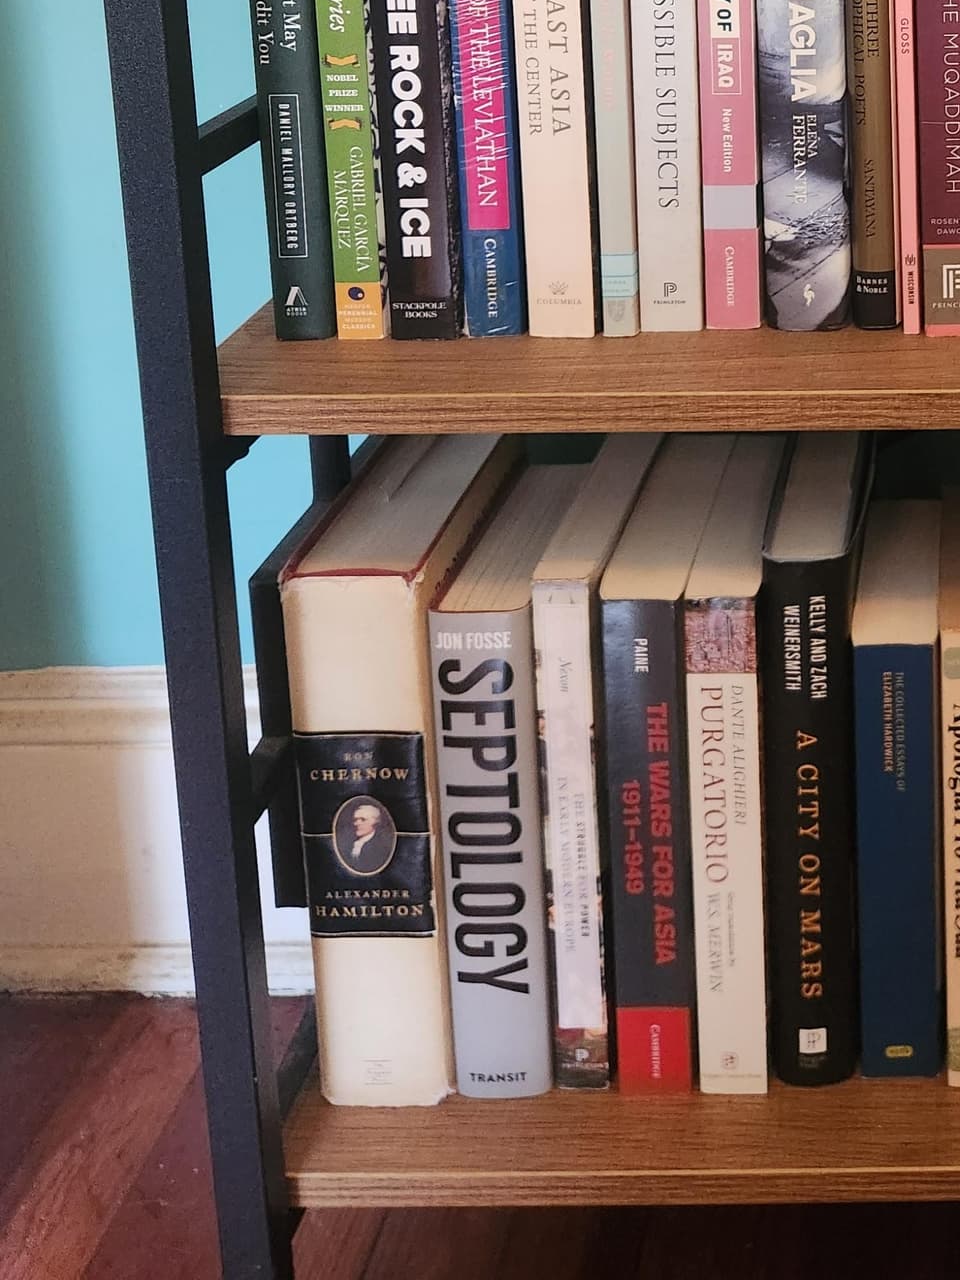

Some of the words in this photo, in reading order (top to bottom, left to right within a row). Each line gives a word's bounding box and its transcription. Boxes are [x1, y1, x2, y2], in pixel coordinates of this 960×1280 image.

[281, 13, 301, 52] May
[716, 8, 732, 32] OF
[900, 18, 909, 54] GLOSS
[389, 45, 426, 155] ROCK
[550, 68, 571, 136] ASIA
[651, 88, 679, 209] SUBJECTS
[396, 162, 428, 188] &
[399, 198, 432, 258] ICE
[484, 238, 498, 318] CAMBRIDGE
[809, 596, 826, 633] KELLY
[435, 633, 462, 649] JON
[467, 632, 512, 649] FOSSE
[633, 638, 649, 673] PAINE
[784, 605, 802, 690] WEINERSMITH
[809, 639, 826, 662] AND
[810, 667, 827, 699] ZACH
[646, 702, 669, 753] THE
[731, 685, 745, 736] DANTE
[797, 730, 818, 750] A
[310, 768, 409, 781] CHERNOW
[649, 760, 672, 837] WARS
[700, 687, 729, 884] PURGATORIO
[732, 745, 746, 825] ALIGHIERI
[438, 658, 530, 994] SEPTOLOGY
[797, 764, 820, 840] CITY
[326, 890, 410, 899] ALEXANDER
[651, 846, 674, 897] FOR
[800, 856, 820, 896] ON
[316, 905, 424, 917] HAMILTON
[654, 904, 677, 965] ASIA
[801, 910, 822, 999] MARS
[470, 1072, 527, 1082] TRANSIT
